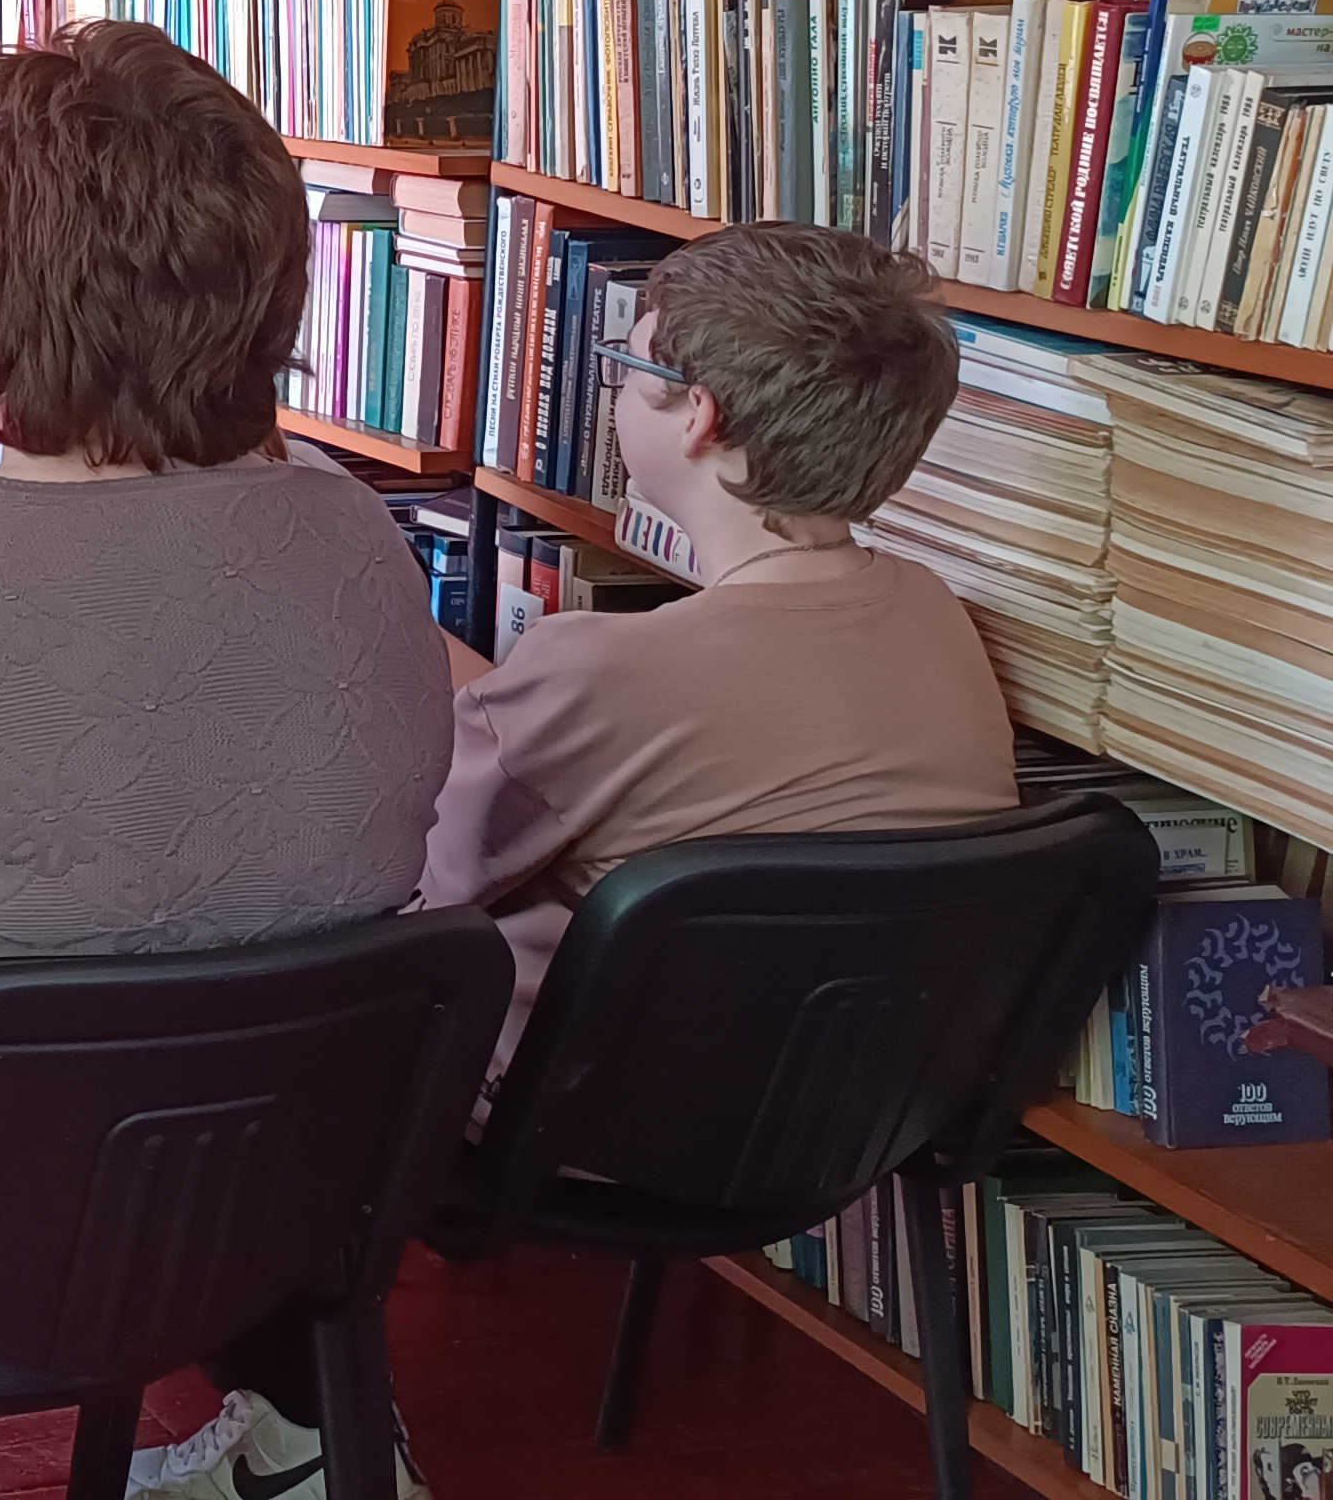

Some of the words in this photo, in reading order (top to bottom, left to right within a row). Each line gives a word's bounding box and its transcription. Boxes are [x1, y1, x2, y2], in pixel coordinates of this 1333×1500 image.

[1287, 27, 1333, 38] мастер-
[1051, 126, 1061, 156] ТЕАТР
[1059, 201, 1085, 290] СОВЕТСКОЙ
[1073, 132, 1095, 198] РОДИНЕ
[1085, 11, 1108, 129] ПОСВЯЩАЕТСЯ
[1153, 124, 1177, 197] РАНЕВСКАЯ
[1167, 136, 1190, 216] ТЕАТРАЛЬНЫЙ
[1196, 172, 1215, 229] театральный
[1208, 122, 1227, 168] календарь
[1218, 174, 1236, 232] театральный
[1230, 125, 1248, 169] календарь
[1244, 146, 1267, 216] ЧАЙКОВСКИЙ
[1316, 151, 1331, 184] СВЕТУ
[1311, 189, 1323, 206] ПО
[1145, 199, 1164, 241] ФАИНА
[1305, 213, 1319, 241] ИДУТ
[1155, 220, 1175, 282] КАЛЕНДАРЬ
[497, 230, 507, 318] РОЖДЕСТВЕНСКОГО
[592, 288, 602, 331] ТЕАТРЕ
[540, 364, 553, 388] ПОД
[537, 393, 550, 437] ПЕСНЯХ
[1140, 964, 1152, 1033] верующим
[1143, 1085, 1157, 1119] 100
[1232, 1103, 1272, 1113] ответов
[1239, 1083, 1267, 1102] 100
[1223, 1113, 1282, 1125] верующим
[1108, 1283, 1119, 1334] СКАЗКА
[1110, 1337, 1122, 1406] КАМЕННАЯ
